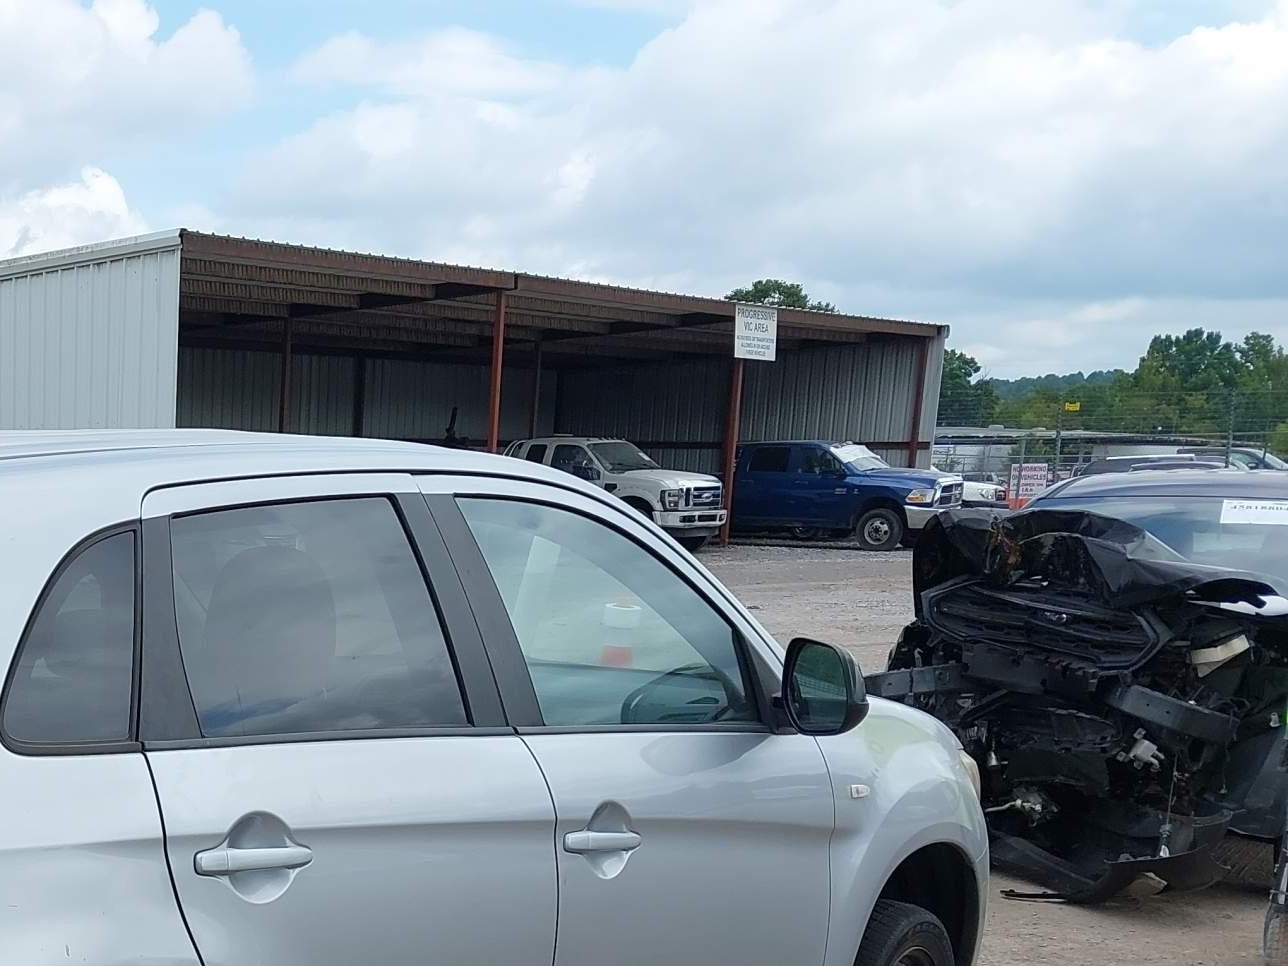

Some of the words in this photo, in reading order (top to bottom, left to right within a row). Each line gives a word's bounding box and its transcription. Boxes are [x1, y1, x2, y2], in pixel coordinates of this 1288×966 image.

[738, 308, 776, 321] PROGRESSIVE
[744, 321, 753, 331] VIC
[754, 323, 768, 332] AREA
